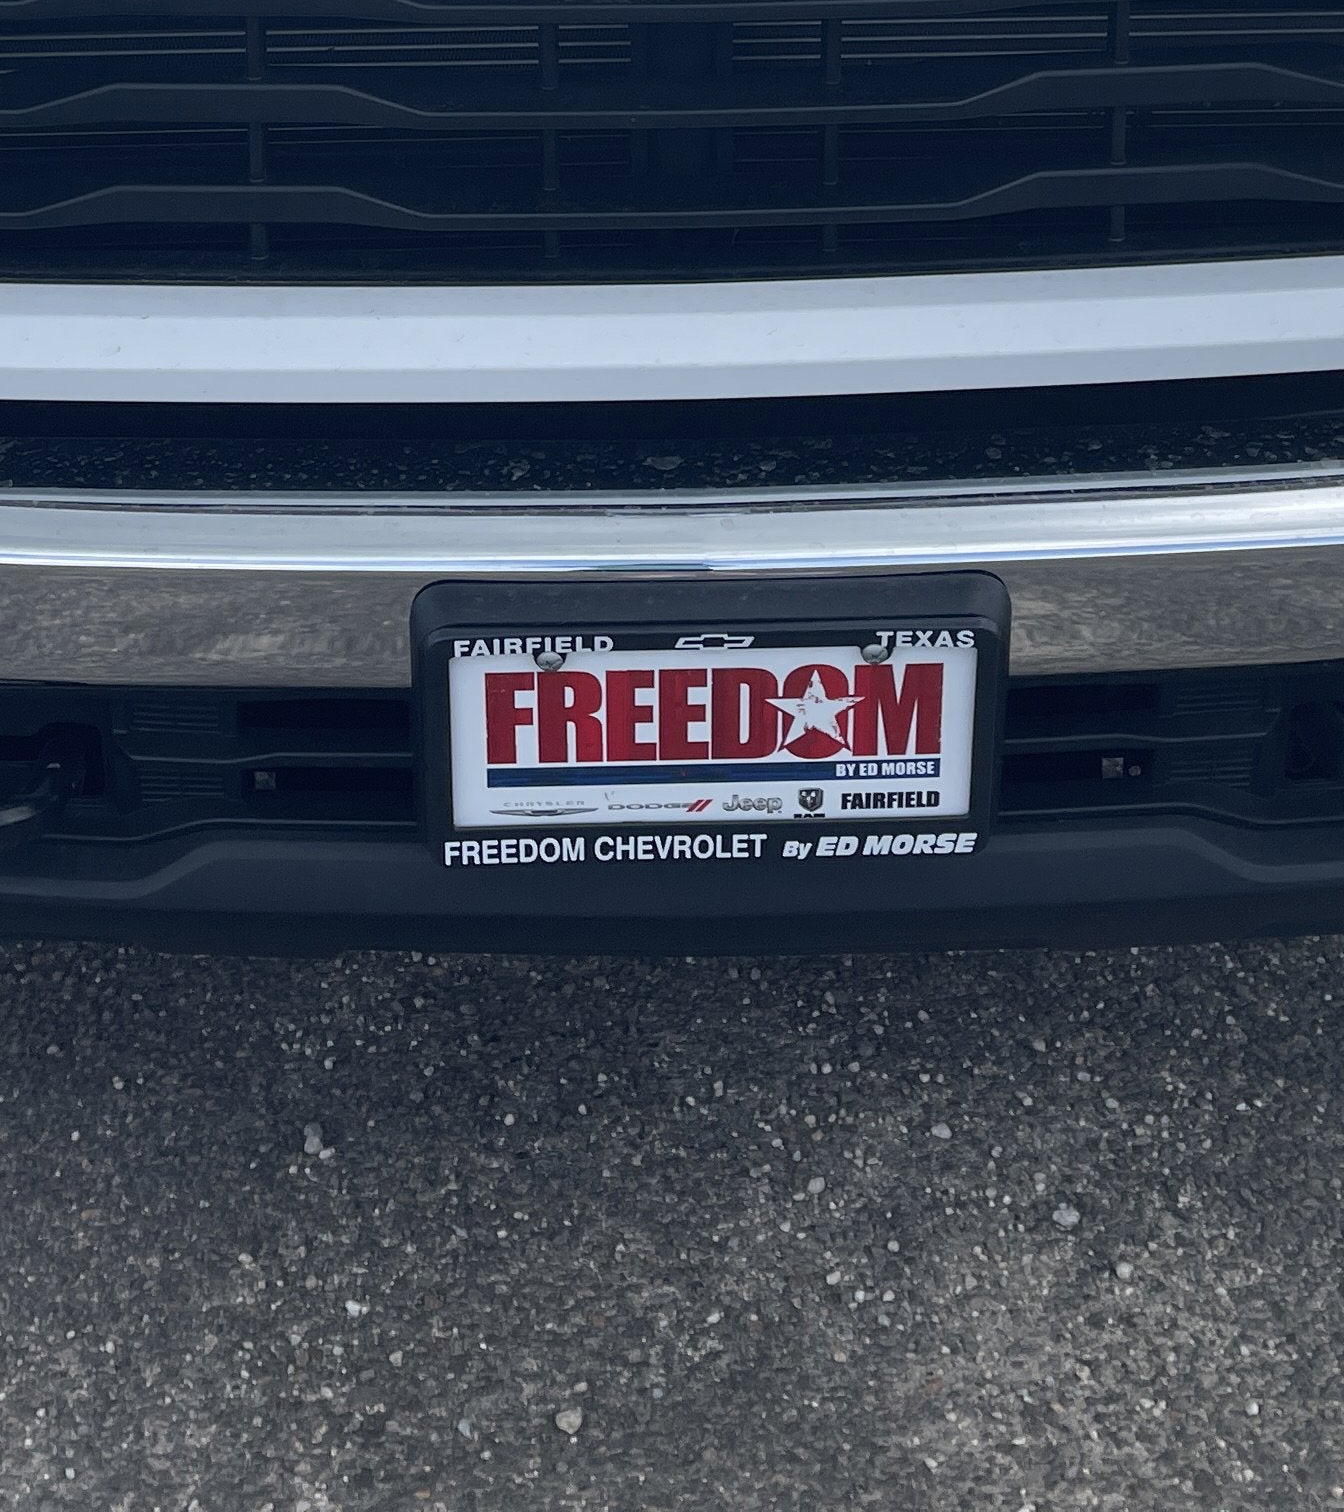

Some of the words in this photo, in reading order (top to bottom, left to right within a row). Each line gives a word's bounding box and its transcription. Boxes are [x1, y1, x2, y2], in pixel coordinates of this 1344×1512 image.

[453, 636, 614, 658] FAIRFIELD
[875, 630, 975, 649] TEXAS
[484, 662, 945, 765] FREEDOM
[835, 762, 856, 777] BY
[859, 762, 877, 776] ED
[881, 760, 935, 776] MORSE
[722, 794, 783, 813] Jeep
[840, 790, 941, 810] FAIRFIELD
[443, 836, 586, 866] FREEDOM
[593, 834, 768, 862] CHEVROLET
[782, 840, 813, 860] By
[815, 835, 859, 857] ED
[862, 832, 978, 856] MORSE
